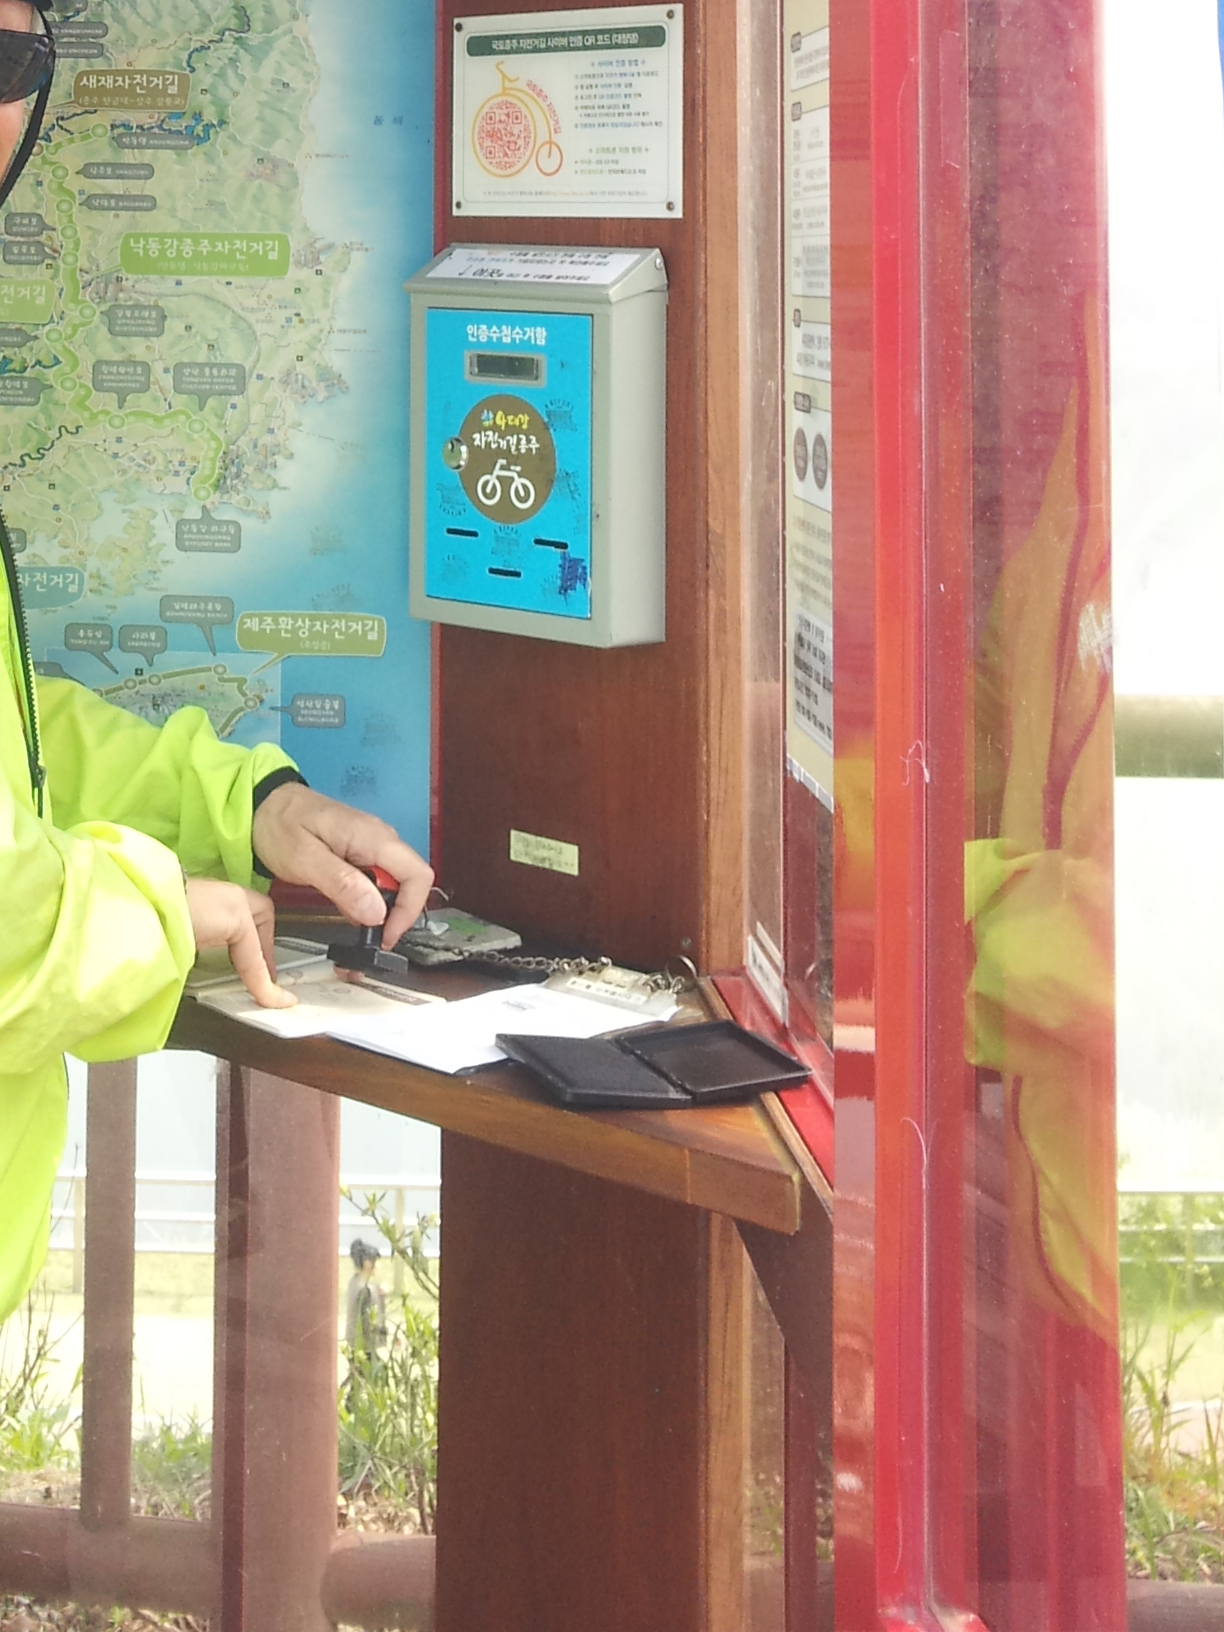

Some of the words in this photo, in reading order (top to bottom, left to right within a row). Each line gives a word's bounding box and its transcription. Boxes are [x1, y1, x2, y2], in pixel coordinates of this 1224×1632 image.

[79, 74, 179, 94] 새재자전거길
[130, 237, 279, 261] 낙동강종주자전거길
[466, 324, 547, 346] 인증수첩수거함
[18, 572, 79, 593] 자전거길
[243, 616, 378, 641] 제주환상자전거길
